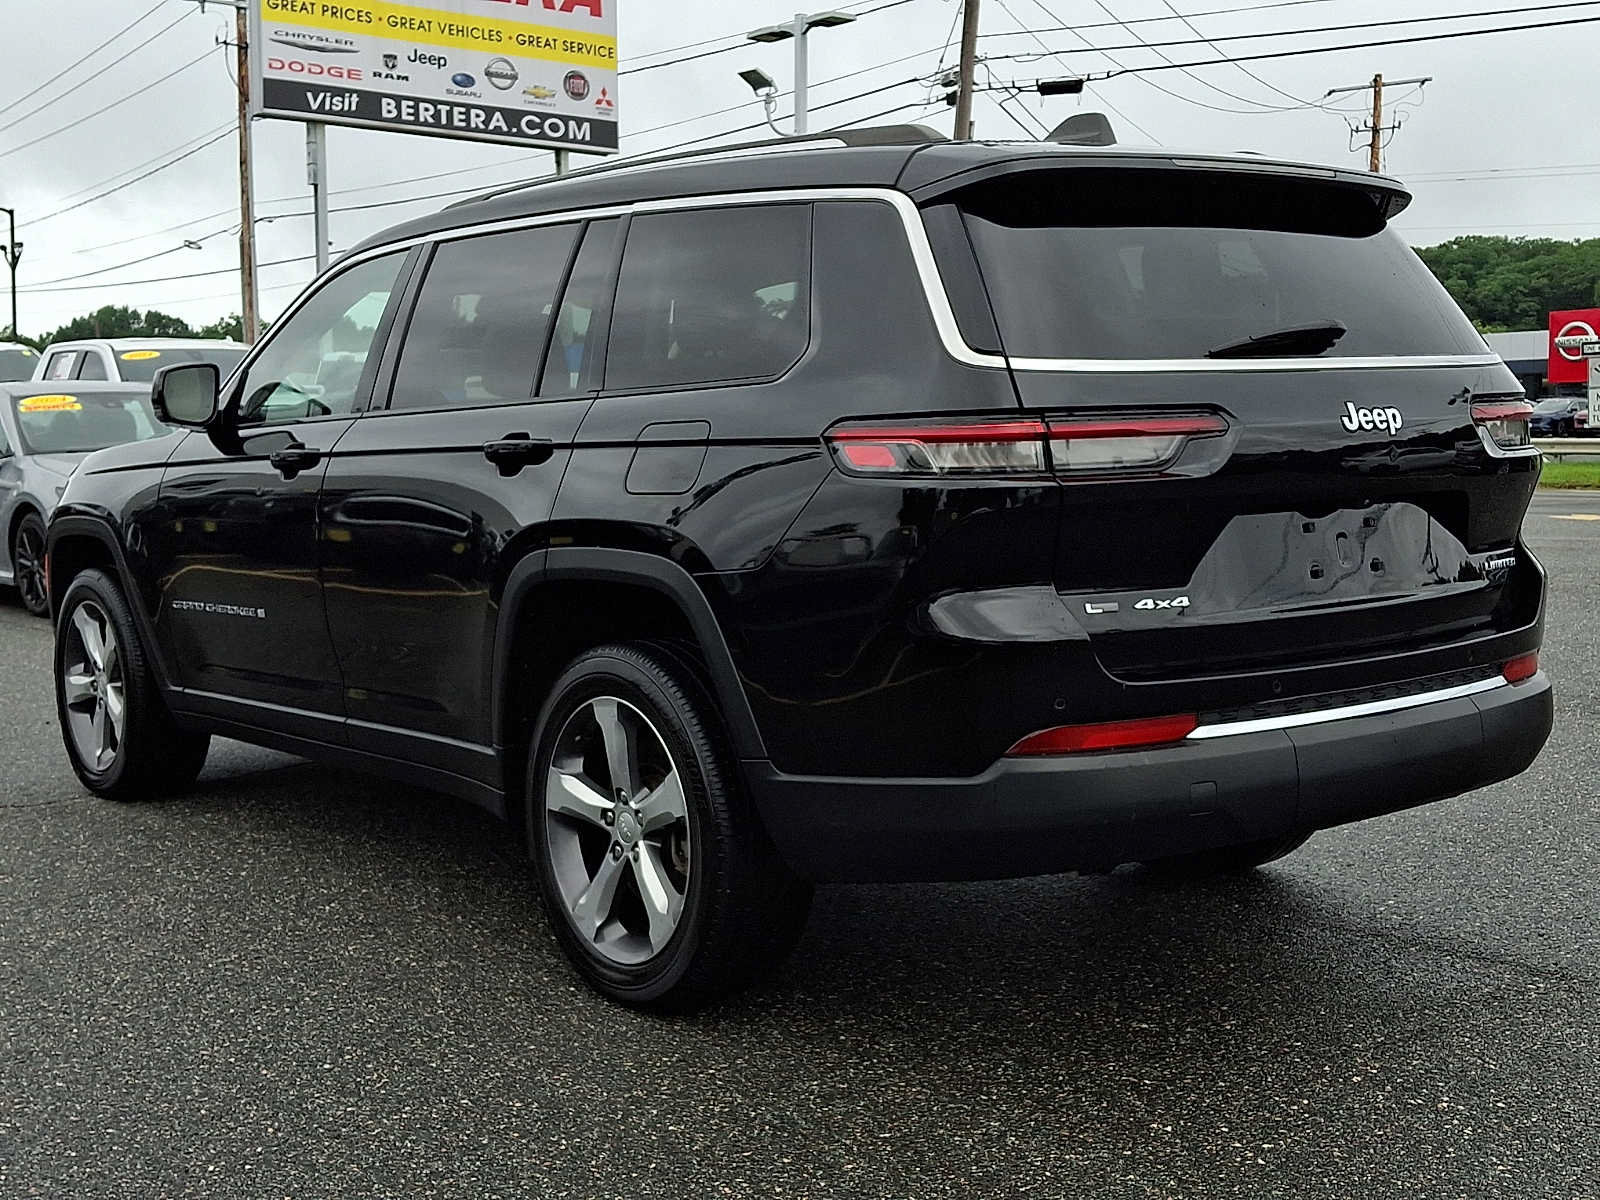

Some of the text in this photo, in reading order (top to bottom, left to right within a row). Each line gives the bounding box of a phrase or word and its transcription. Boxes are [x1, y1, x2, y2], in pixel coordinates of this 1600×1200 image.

[266, 0, 615, 59] GREAT PRICES GREAT VEHICLES GREAT SERVICE
[273, 30, 354, 46] CHRYSLER
[267, 58, 363, 81] DODGE
[407, 49, 447, 69] Jeep
[372, 71, 410, 82] RAM
[305, 91, 591, 142] Visit BERTERA.COM
[1341, 401, 1403, 435] Jeep
[1133, 596, 1191, 610] 4x4
